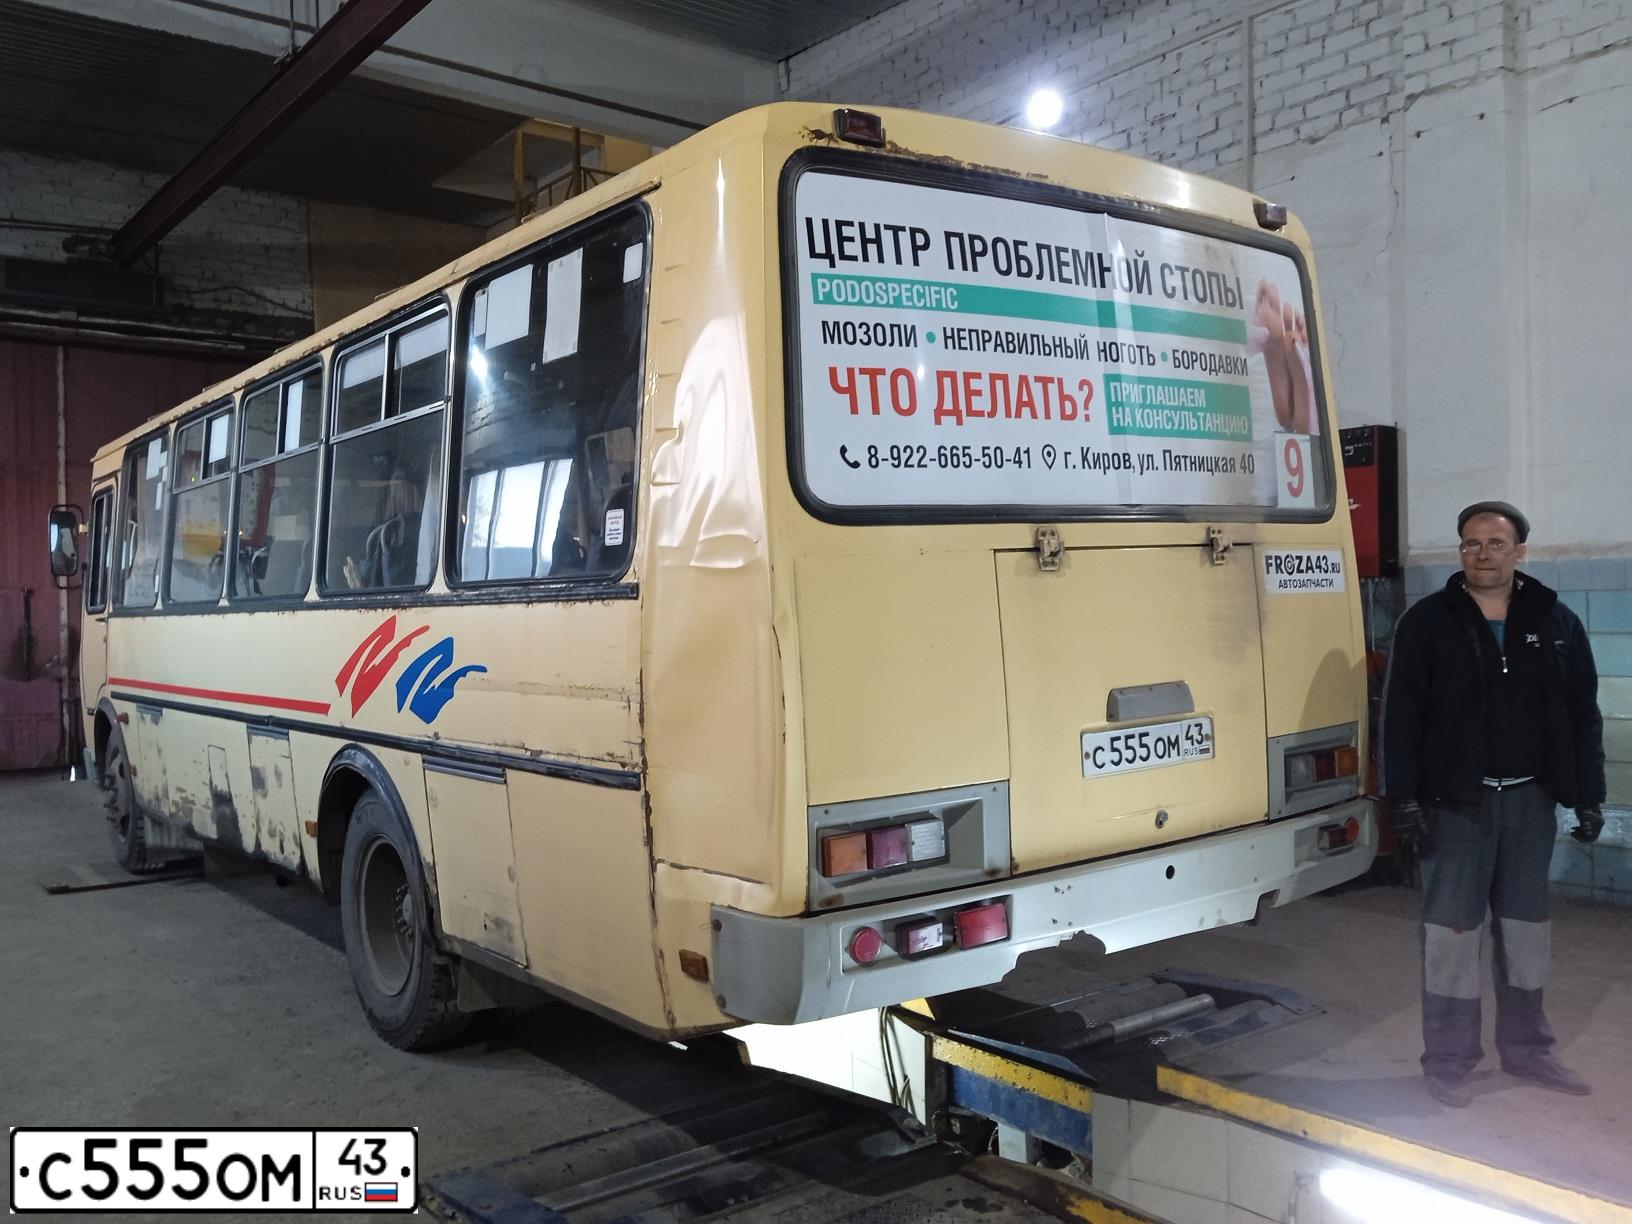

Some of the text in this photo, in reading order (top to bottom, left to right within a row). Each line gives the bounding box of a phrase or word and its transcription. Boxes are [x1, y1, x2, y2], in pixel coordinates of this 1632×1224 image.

[805, 216, 1245, 310] ЦЕНТР ПРОБЛЕМНОЙ СТОПЫ
[817, 278, 959, 310] PODOSPECIFIC
[821, 320, 1249, 376] МОЗОЛИ НЕПРАВИЛЬНЫЙ НОГОТЬ БОРОДАВКИ
[828, 366, 1094, 426] ЧТО ДЕЛАТЬ?
[1109, 382, 1206, 408] ПРИГЛАШАЕМ
[1112, 407, 1249, 436] НА КОНСУЛЬТАНЦИЮ
[867, 444, 1032, 470] 8-922-665-50-41
[1064, 447, 1256, 477] г. Киров, ул. Пятницкая 40
[1283, 438, 1305, 498] 9
[1278, 578, 1334, 589] АВТОЗАПЧАСТИ
[1184, 722, 1204, 747] 43
[1183, 746, 1199, 757] RUS
